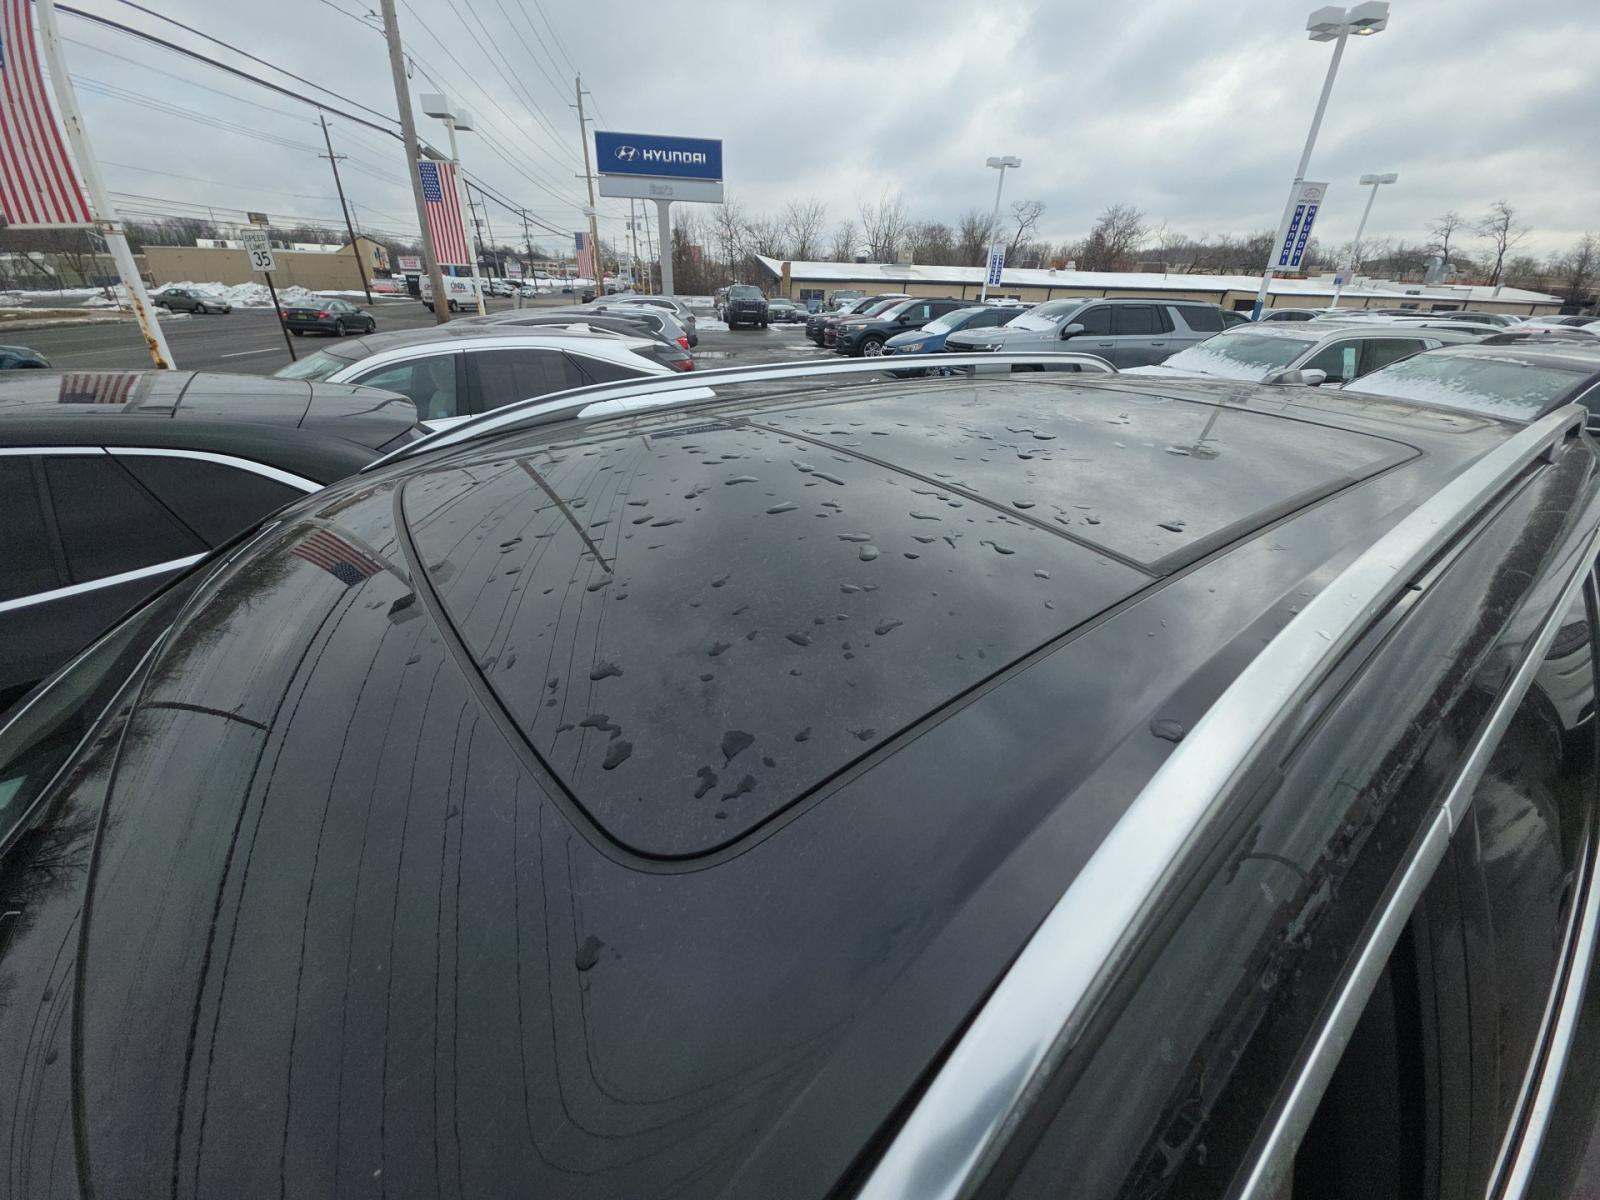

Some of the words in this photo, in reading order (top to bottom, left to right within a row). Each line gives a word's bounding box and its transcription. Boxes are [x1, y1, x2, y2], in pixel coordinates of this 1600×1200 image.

[643, 149, 706, 164] HYUNDAI
[1282, 207, 1304, 264] HYUNDAI
[1293, 207, 1316, 265] HYUNDAI
[253, 251, 271, 267] 35
